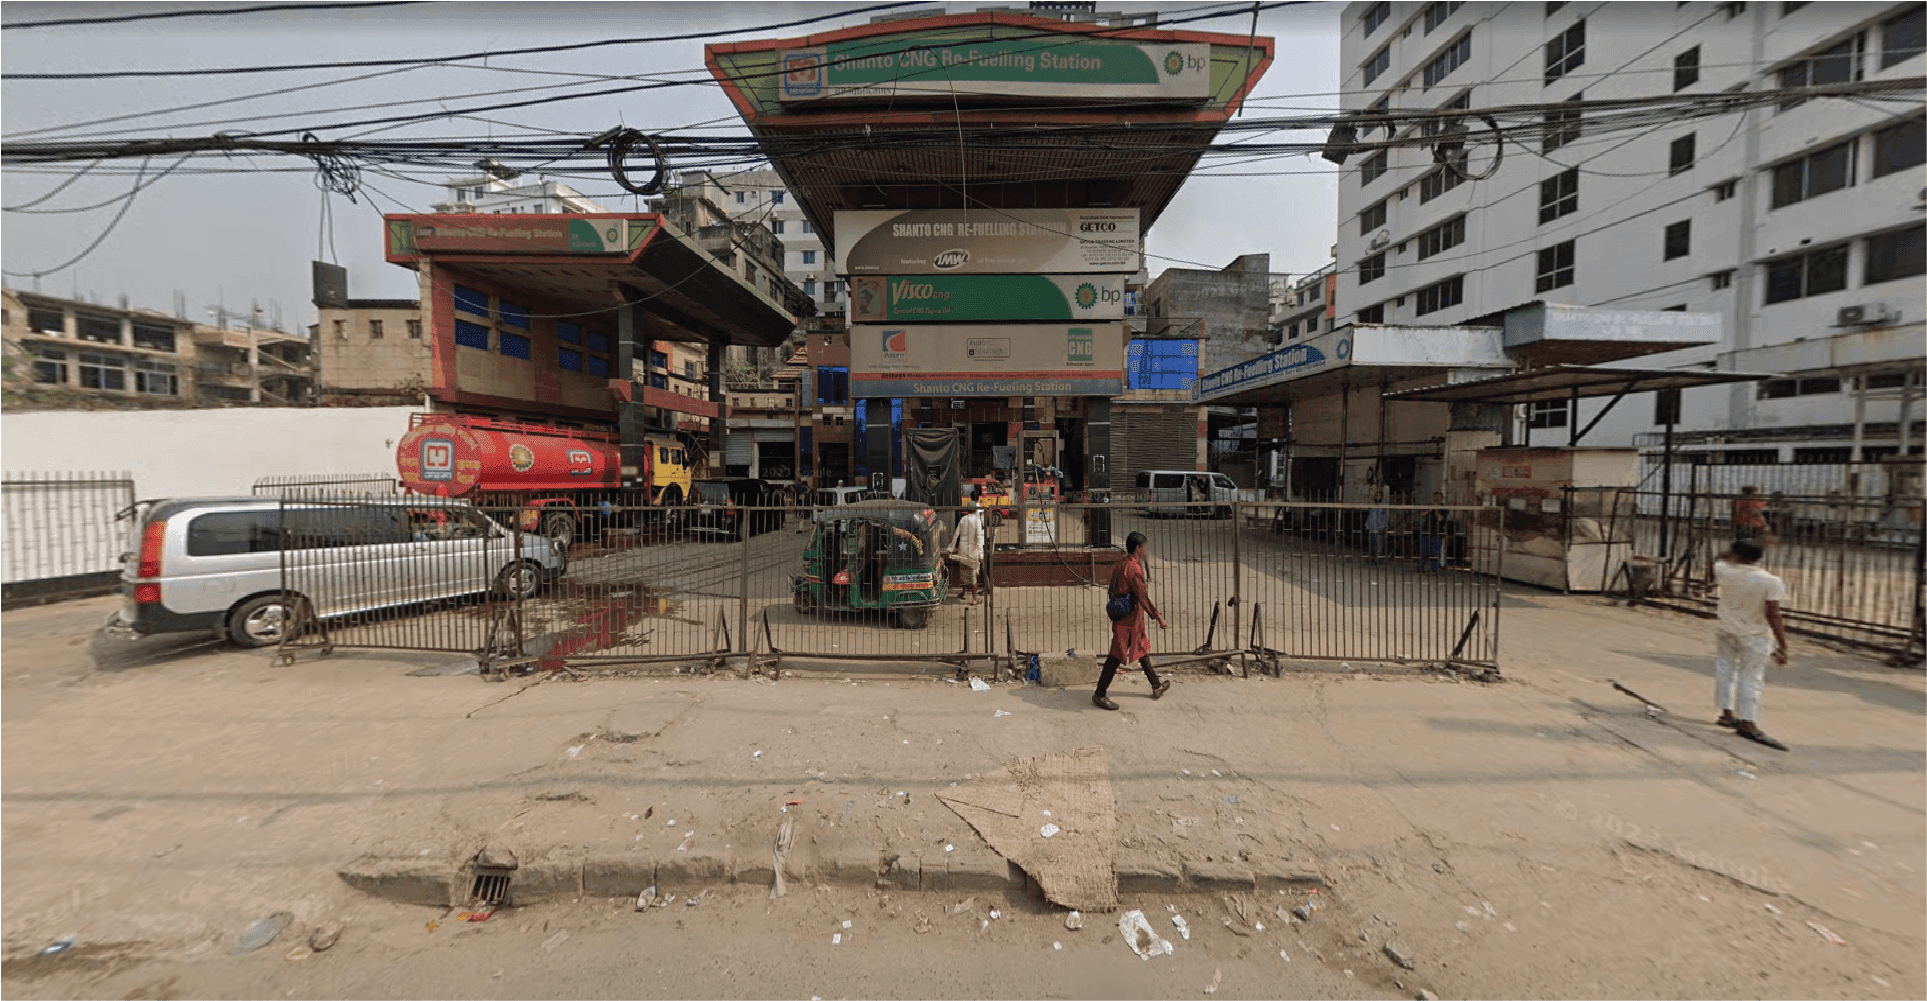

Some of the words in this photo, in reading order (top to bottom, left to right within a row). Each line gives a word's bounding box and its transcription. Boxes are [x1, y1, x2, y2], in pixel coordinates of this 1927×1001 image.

[834, 54, 894, 71] Shanto
[900, 50, 936, 68] CNG
[942, 49, 1035, 72] Re-Fuelling
[1040, 52, 1101, 69] Station
[1188, 54, 1206, 72] bp
[533, 228, 562, 238] Station
[892, 223, 931, 237] SHANTO
[933, 222, 953, 236] CNG
[957, 222, 1017, 236] RE-FUELLING
[1080, 222, 1116, 232] GETCO
[900, 257, 927, 265] featuring
[1101, 286, 1121, 305] bp
[1068, 341, 1092, 355] CNG
[1275, 347, 1307, 369] Station
[913, 383, 950, 393] Shanto
[951, 383, 974, 392] CNG
[977, 382, 1033, 394] Re-Fuelling
[1035, 381, 1072, 391] Station
